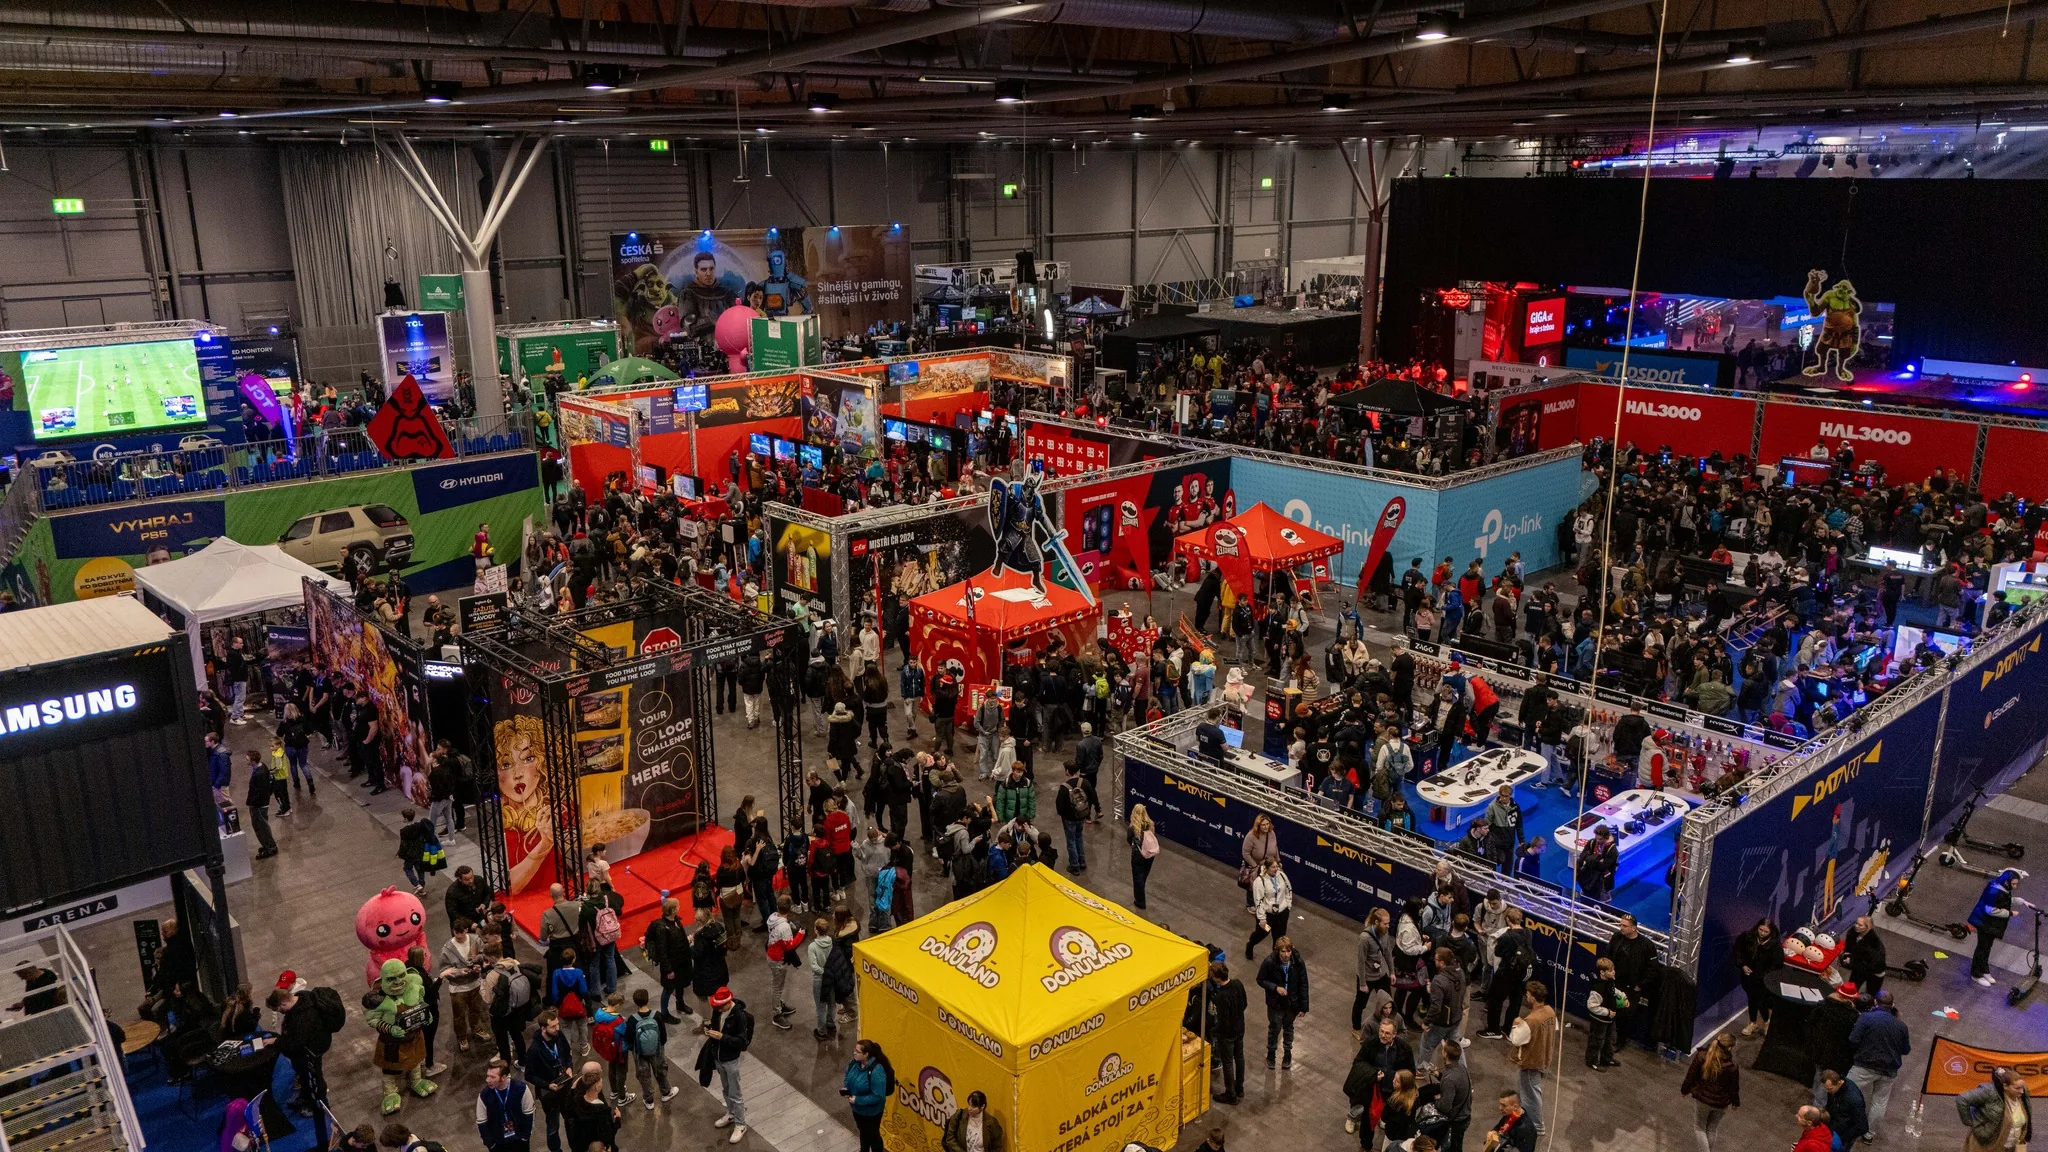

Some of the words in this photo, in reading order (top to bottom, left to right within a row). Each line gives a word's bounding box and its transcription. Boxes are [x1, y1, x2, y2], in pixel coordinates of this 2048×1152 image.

[620, 242, 652, 256] ČESKÁ
[817, 280, 852, 293] Silnější
[861, 278, 903, 292] gamingu,
[818, 292, 858, 305] #silnější
[872, 289, 900, 301] životě
[1530, 311, 1547, 324] GIGA
[1613, 361, 1686, 384] Tpsport
[1544, 398, 1576, 414] HAL3000
[1626, 400, 1702, 422] HAL3000
[1819, 422, 1912, 446] HAL3000
[460, 472, 504, 486] HYUNDAI
[109, 512, 193, 534] VYHRAJ
[1504, 512, 1542, 544] tp-link
[140, 530, 168, 540] PS5
[868, 536, 890, 550] MISTŘI
[890, 534, 899, 544] ČR
[900, 531, 915, 543] 2024
[92, 578, 132, 588] SOBOTNÍM
[706, 646, 721, 654] FOOD
[736, 639, 752, 648] KEEPS
[707, 653, 719, 661] YOU
[738, 645, 752, 654] LOOP
[1414, 642, 1434, 654] ZAGG
[606, 670, 622, 680] FOOD
[623, 667, 638, 676] THAT
[638, 663, 656, 673] KEEPS
[1502, 666, 1518, 674] logitech
[1994, 641, 2030, 681] DATART
[606, 677, 619, 686] YOU
[640, 669, 656, 678] LOOP
[1603, 692, 1629, 704] steelseries
[0, 684, 136, 736] MSUNG
[639, 710, 667, 726] YOUR
[1655, 706, 1683, 719] steelseries
[658, 718, 692, 740] LOOP
[1708, 719, 1740, 734] HYPERX
[642, 731, 692, 756] CHALLENGE
[1769, 734, 1801, 748] HYPERX
[631, 760, 670, 786] HERE
[1812, 752, 1866, 806] DATART
[1148, 796, 1163, 806] ASUS
[1178, 780, 1213, 801] DATART
[1333, 842, 1376, 866] DATART
[1305, 860, 1328, 874] SAMSUNG
[37, 901, 106, 929] ARENA
[919, 936, 1000, 989] DONULAND
[1040, 942, 1133, 993] DONULAND
[863, 959, 919, 1004] DONULAND
[1129, 966, 1196, 1011] DONULAND
[938, 1006, 1003, 1058] DONULAND
[1029, 1013, 1105, 1060] DONULAND
[1085, 1063, 1134, 1096] DONULAND
[899, 1084, 948, 1130] DONU
[1058, 1096, 1108, 1136] SLADKÁ
[1110, 1074, 1159, 1106] CHVÍLE,
[1094, 1108, 1126, 1136] STOJÍ
[1126, 1100, 1144, 1118] ZA
